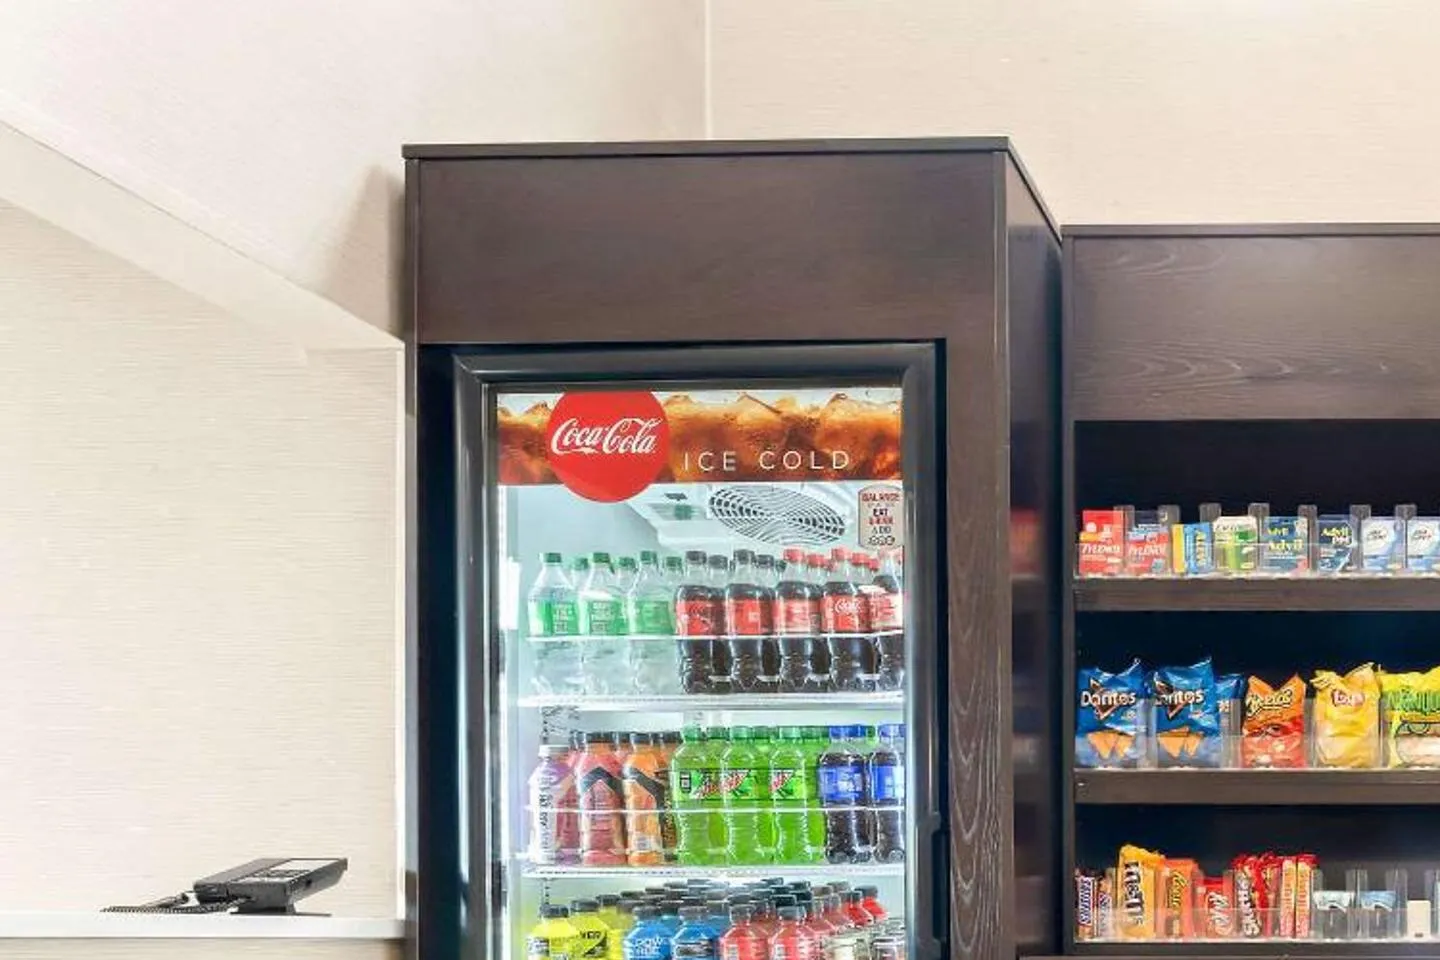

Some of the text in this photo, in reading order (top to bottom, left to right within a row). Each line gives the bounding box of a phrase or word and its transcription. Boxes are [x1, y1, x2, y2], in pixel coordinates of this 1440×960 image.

[551, 417, 662, 456] Coca-Cola
[683, 450, 851, 472] ICE COLD
[1266, 540, 1303, 552] Advil
[1080, 689, 1137, 707] Doritos
